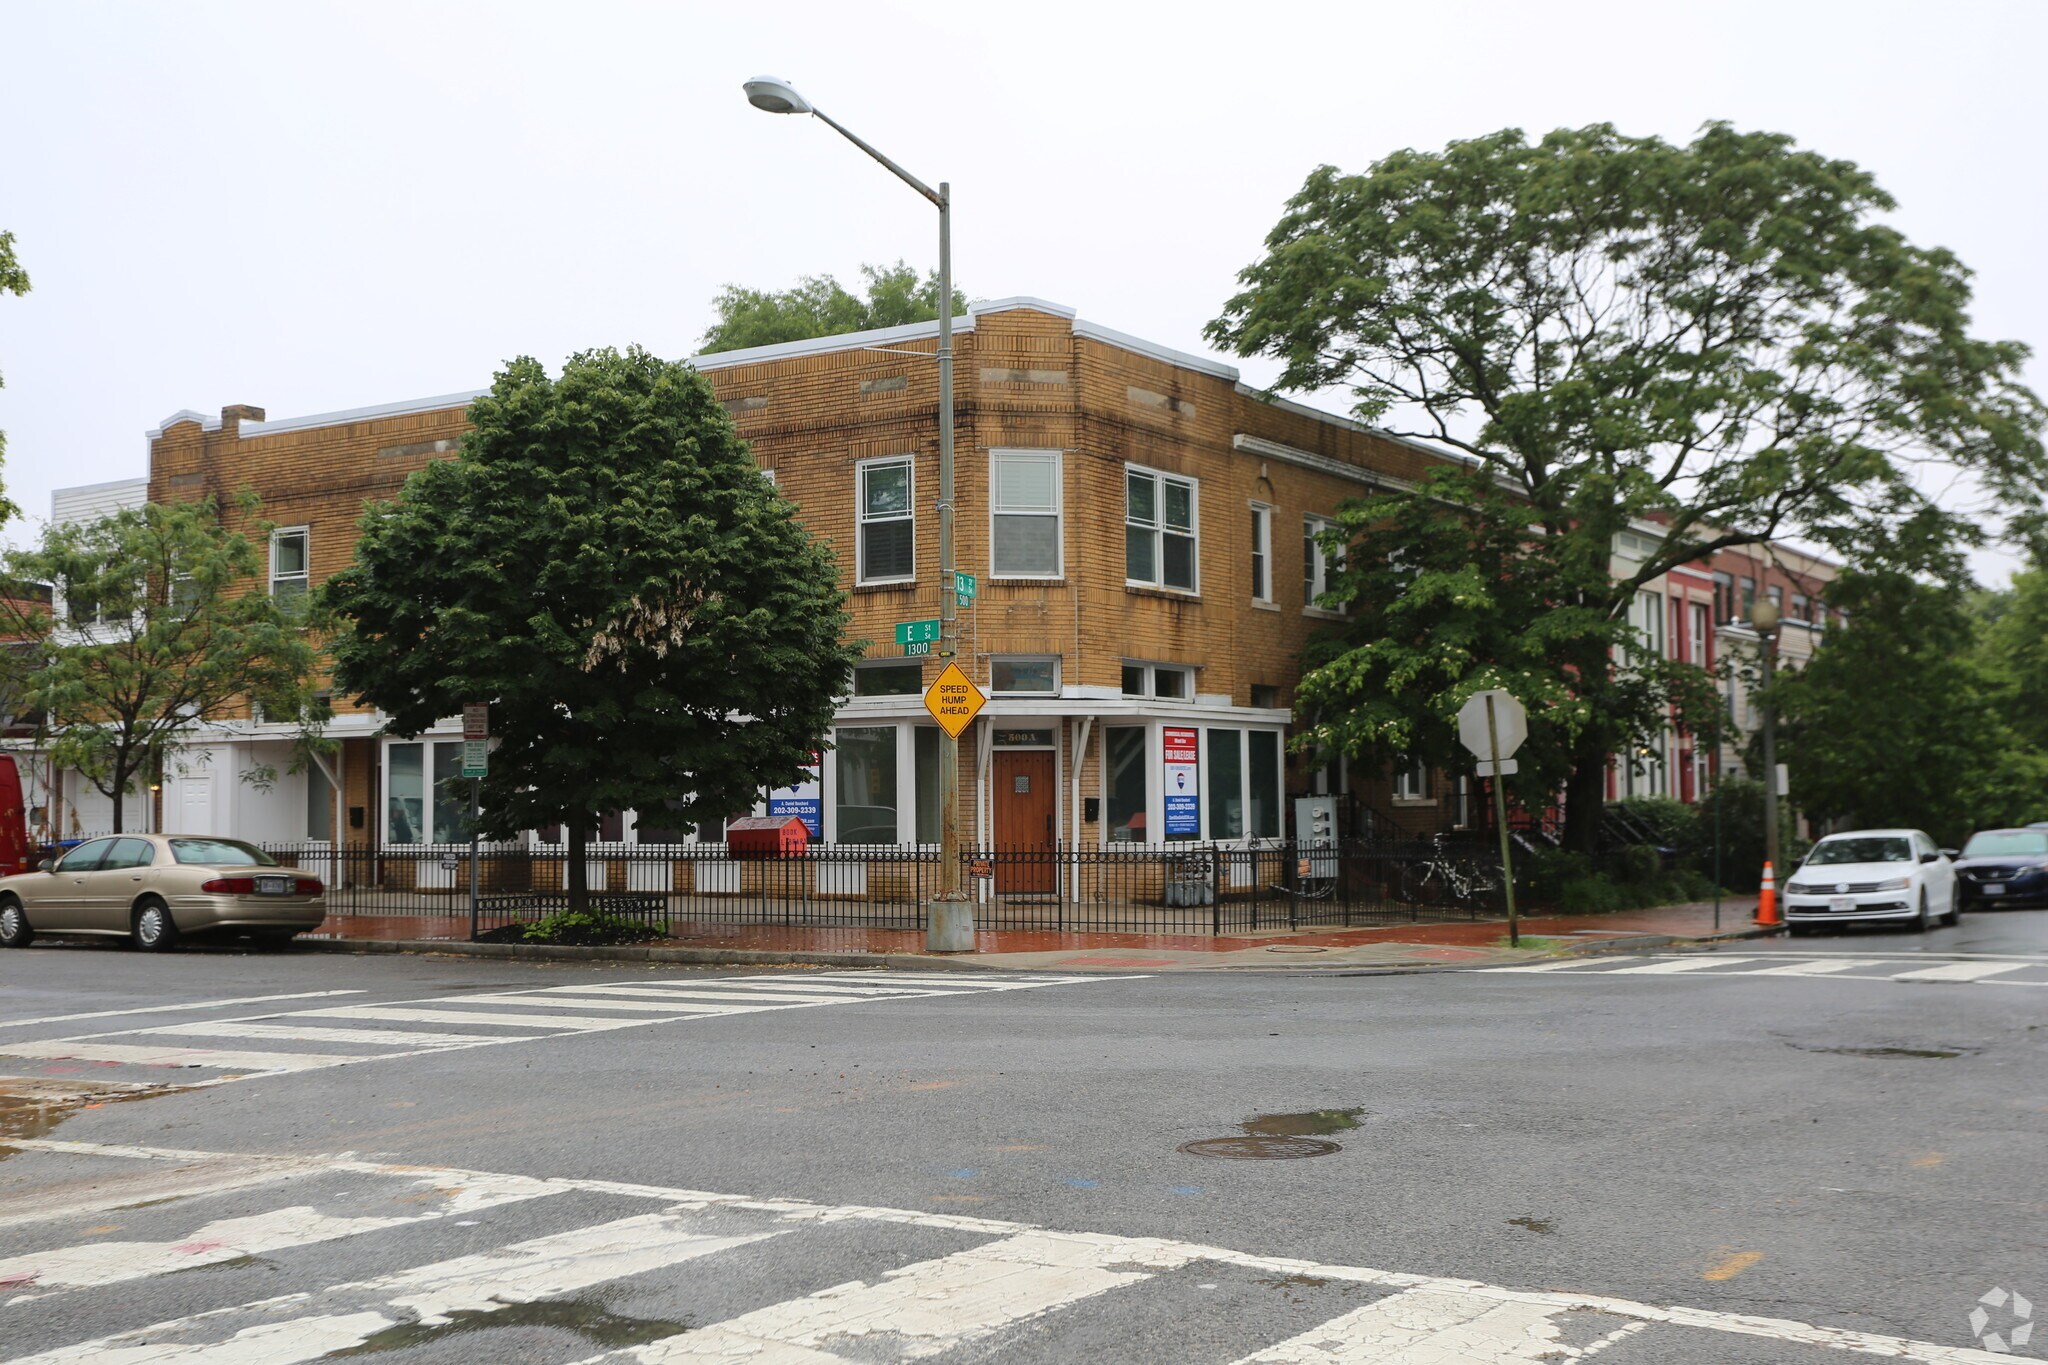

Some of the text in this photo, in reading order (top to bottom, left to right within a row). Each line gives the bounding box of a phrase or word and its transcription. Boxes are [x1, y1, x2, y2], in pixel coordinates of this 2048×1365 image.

[956, 575, 965, 592] 13
[959, 594, 969, 607] 500
[907, 625, 914, 641] E
[908, 642, 928, 655] 1300
[940, 685, 968, 693] SPEED
[941, 696, 966, 704] HUMP
[940, 707, 969, 715] AHEAD
[1008, 733, 1036, 741] 500A
[773, 806, 816, 814] 202-309-2339
